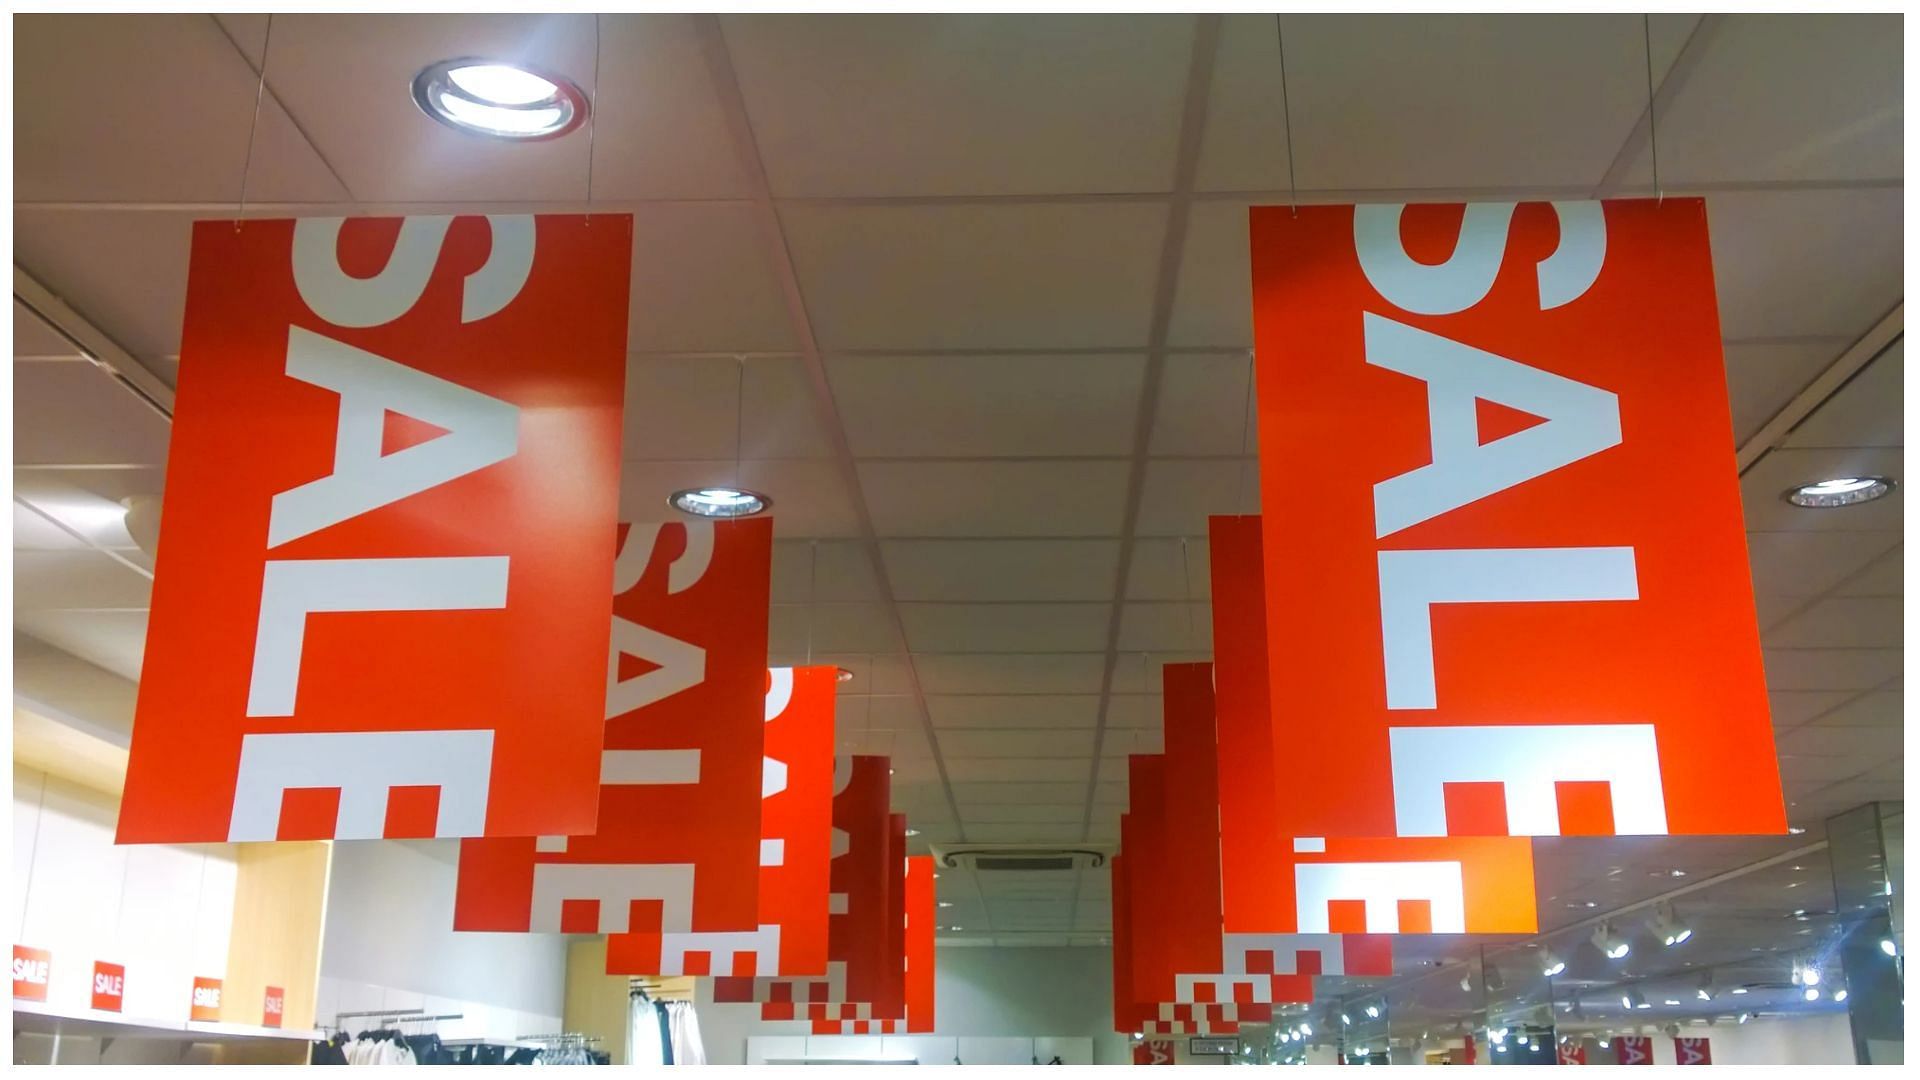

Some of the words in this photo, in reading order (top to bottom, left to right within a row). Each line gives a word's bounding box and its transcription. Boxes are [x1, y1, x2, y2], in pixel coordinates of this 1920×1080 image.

[227, 214, 537, 843] SALE
[1353, 201, 1668, 836] SALE
[13, 958, 49, 984] SALE
[95, 973, 123, 996] SALE
[194, 987, 221, 1008] SALE
[266, 997, 283, 1013] SALE
